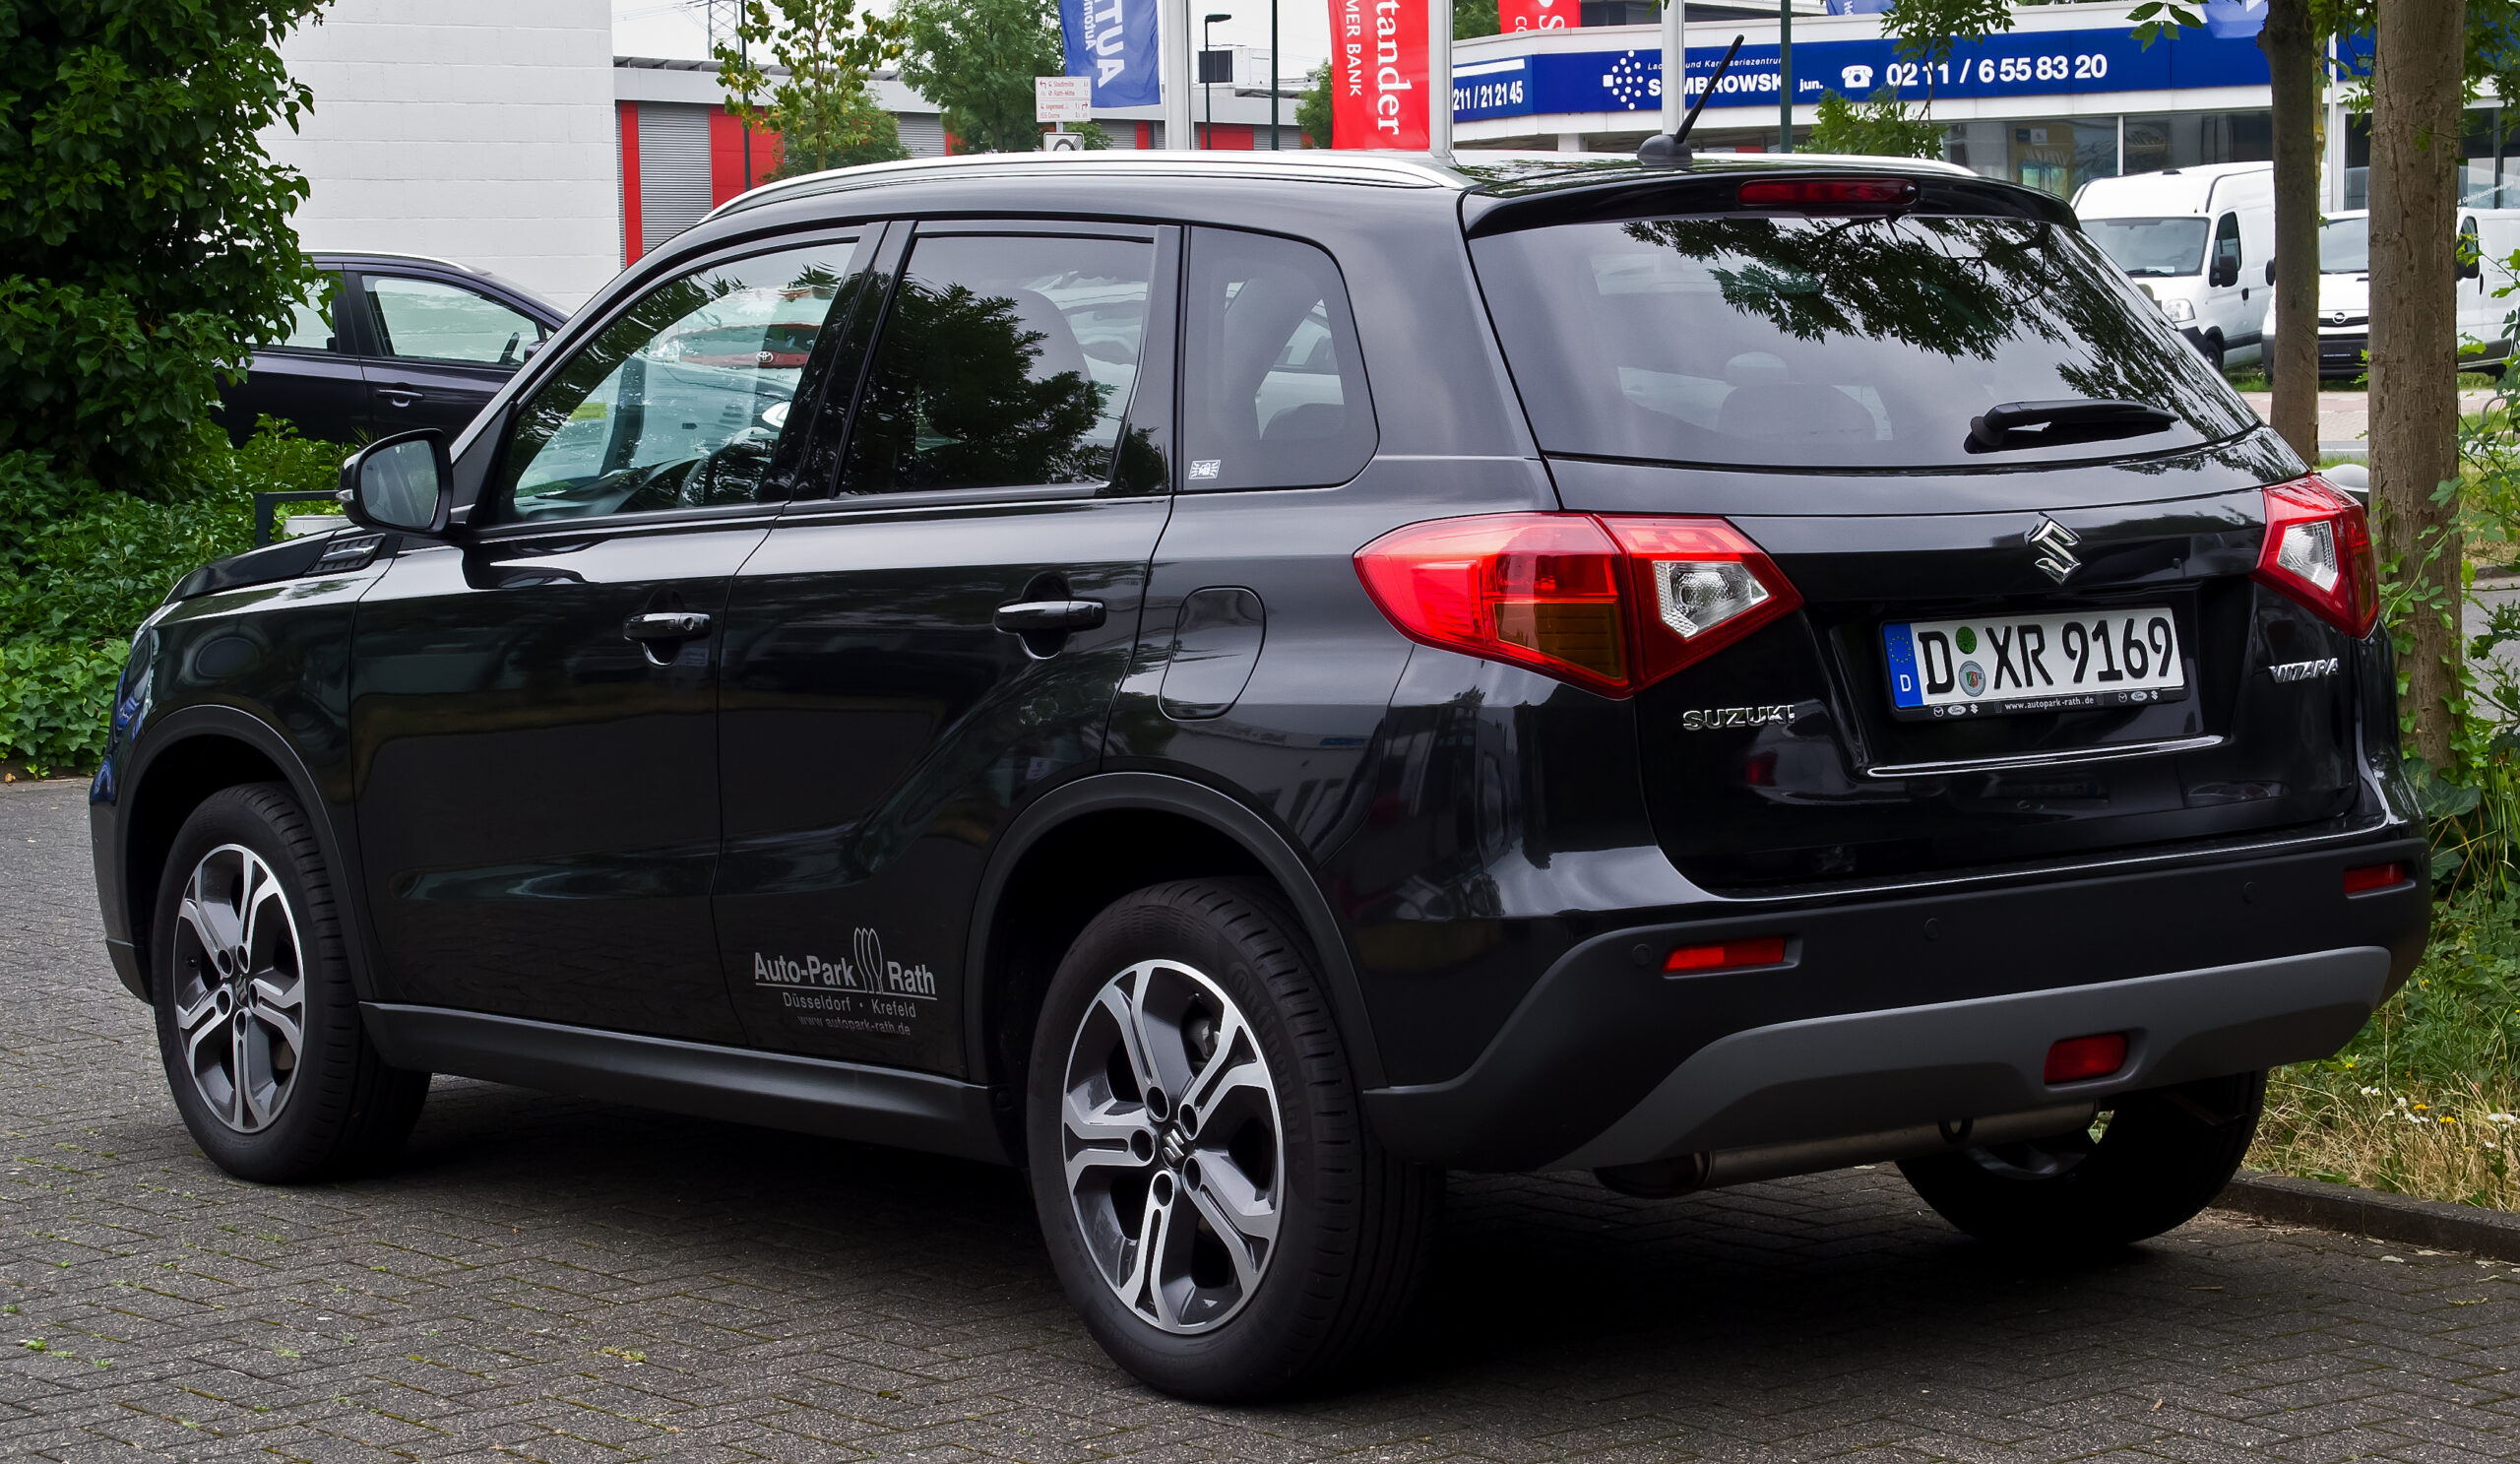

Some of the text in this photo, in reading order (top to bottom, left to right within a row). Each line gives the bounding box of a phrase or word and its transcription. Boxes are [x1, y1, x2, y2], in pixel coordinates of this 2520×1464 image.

[1347, 43, 1361, 96] BANK
[1685, 60, 1702, 69] und
[1704, 57, 1781, 68] Karseriezentru
[1886, 61, 1949, 87] 0211
[1959, 58, 1971, 84] /
[1979, 59, 1995, 83] 6
[1648, 73, 1824, 96] SMBROWSK jun.
[1474, 86, 1480, 110] /
[1918, 616, 2174, 694] D XR 9169
[1900, 674, 1912, 691] D
[2268, 658, 2339, 683] VITARA
[2004, 695, 2094, 711] www.autopark-rath.de
[1682, 704, 1796, 731] SUZUKI
[754, 952, 935, 994] Auto-Park Rath
[783, 991, 916, 1018] Düsseldorf Krefeld
[797, 1015, 911, 1036] wwwautopark-rath.de
